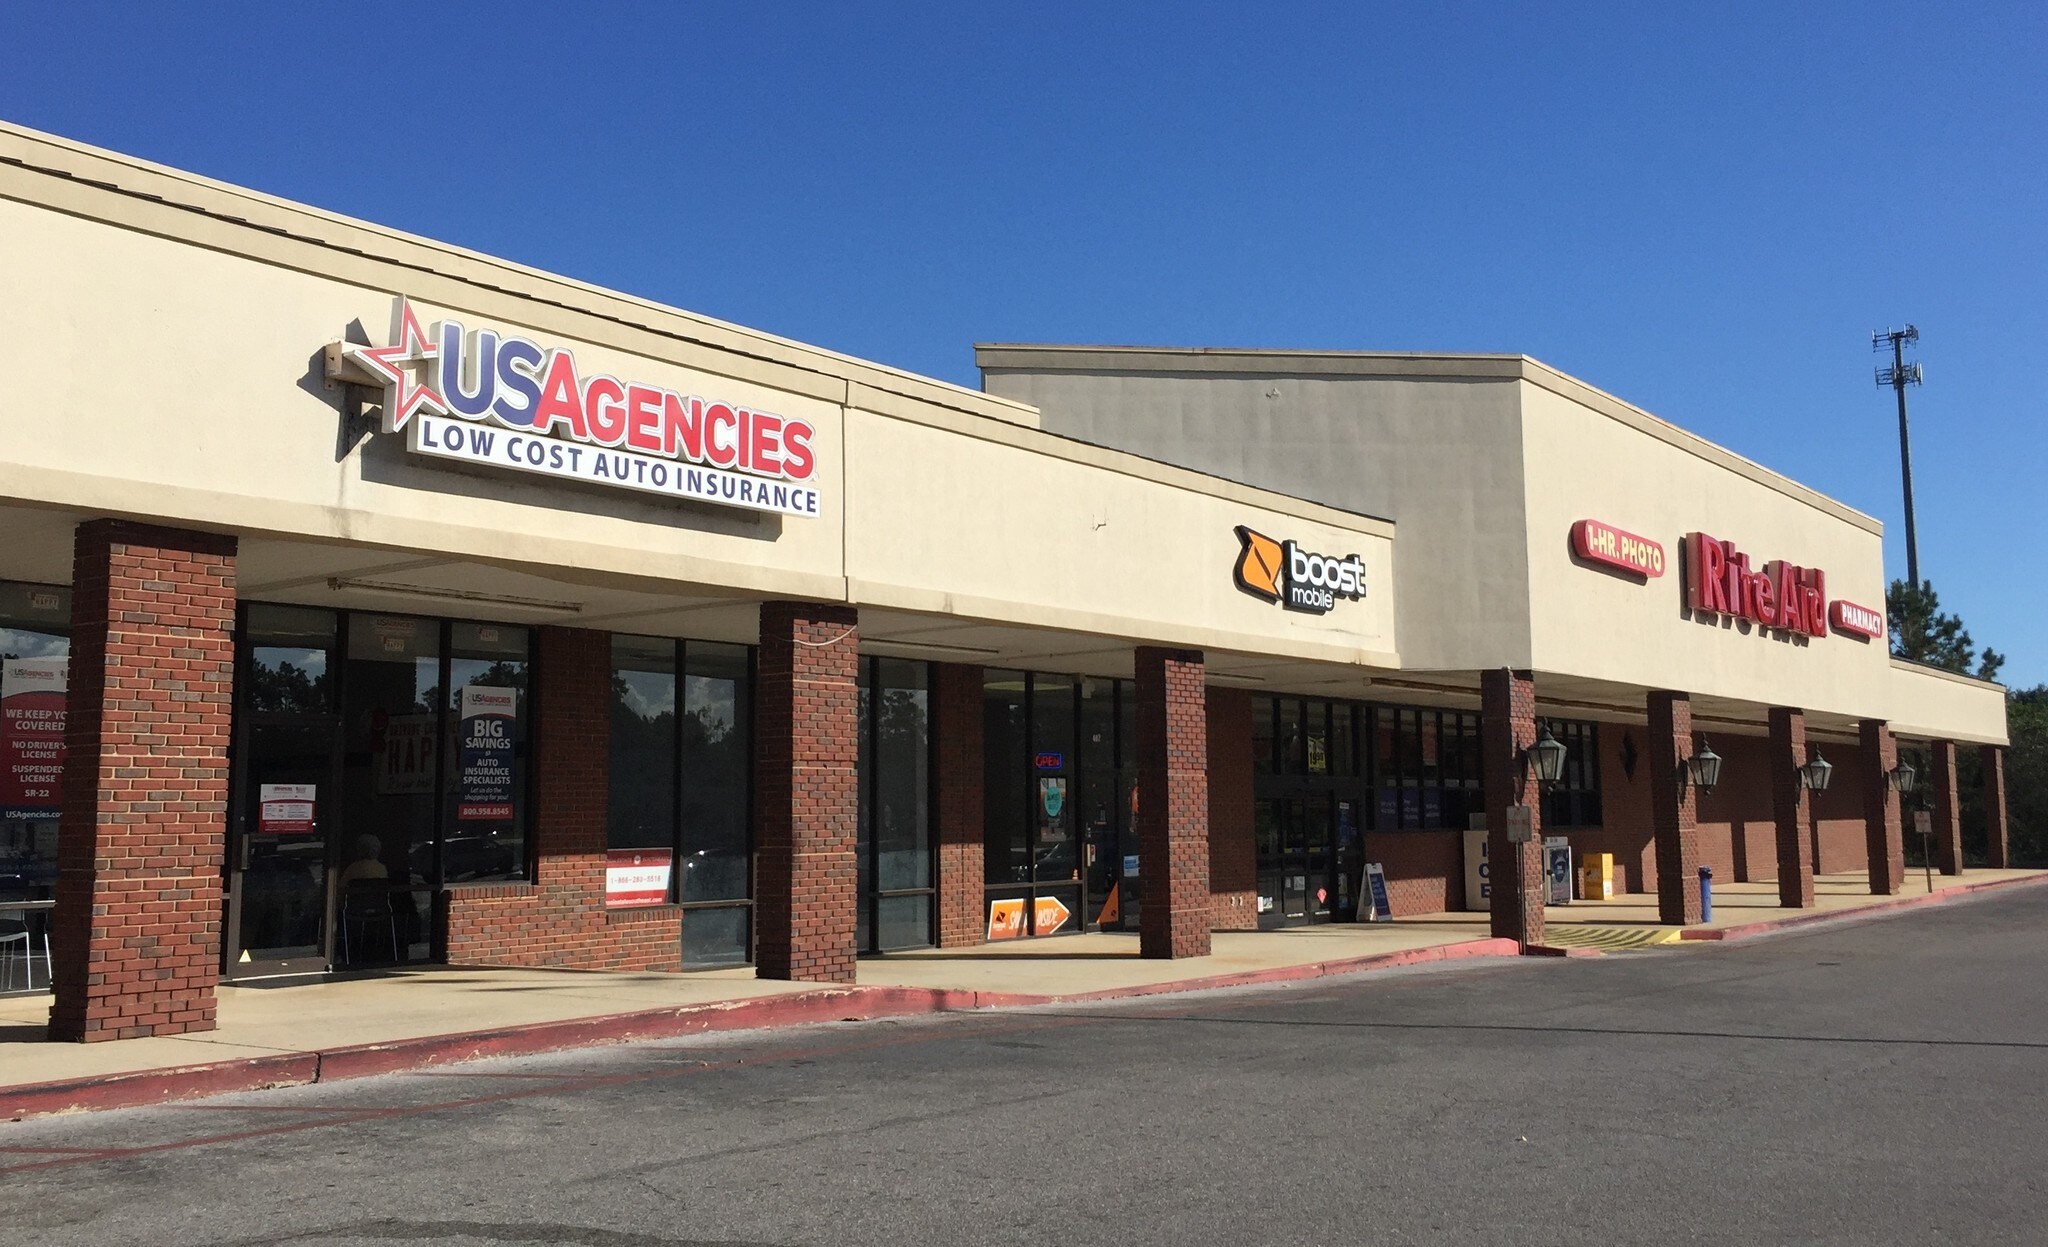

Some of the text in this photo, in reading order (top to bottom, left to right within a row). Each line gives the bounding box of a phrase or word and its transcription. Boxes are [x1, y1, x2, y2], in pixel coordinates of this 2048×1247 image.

[440, 318, 816, 480] USAGENCIES
[423, 420, 818, 514] LOW COST AUTO INSURANCE
[1587, 524, 1662, 573] 1-HR. PHOTO
[1290, 542, 1365, 595] boost
[1697, 531, 1827, 638] Rite Aid
[1292, 586, 1333, 608] mobile
[1841, 603, 1881, 635] PHARMACY
[6, 708, 68, 720] WE KEEP YO
[15, 720, 66, 731] COVERED
[474, 719, 503, 738] BIG
[11, 740, 67, 750] NO DRIVER'S
[465, 737, 511, 749] SAVINGS
[21, 750, 57, 759] LICENSE
[476, 758, 499, 767] AUTO
[1035, 755, 1060, 768] OPEN
[11, 764, 65, 774] SUSPENDED
[465, 767, 510, 776] INSURANCE
[20, 774, 56, 783] LICENSE
[462, 776, 511, 785] SPECIALISTS
[24, 789, 50, 798] SR-22
[5, 810, 63, 820] USAgencies.co
